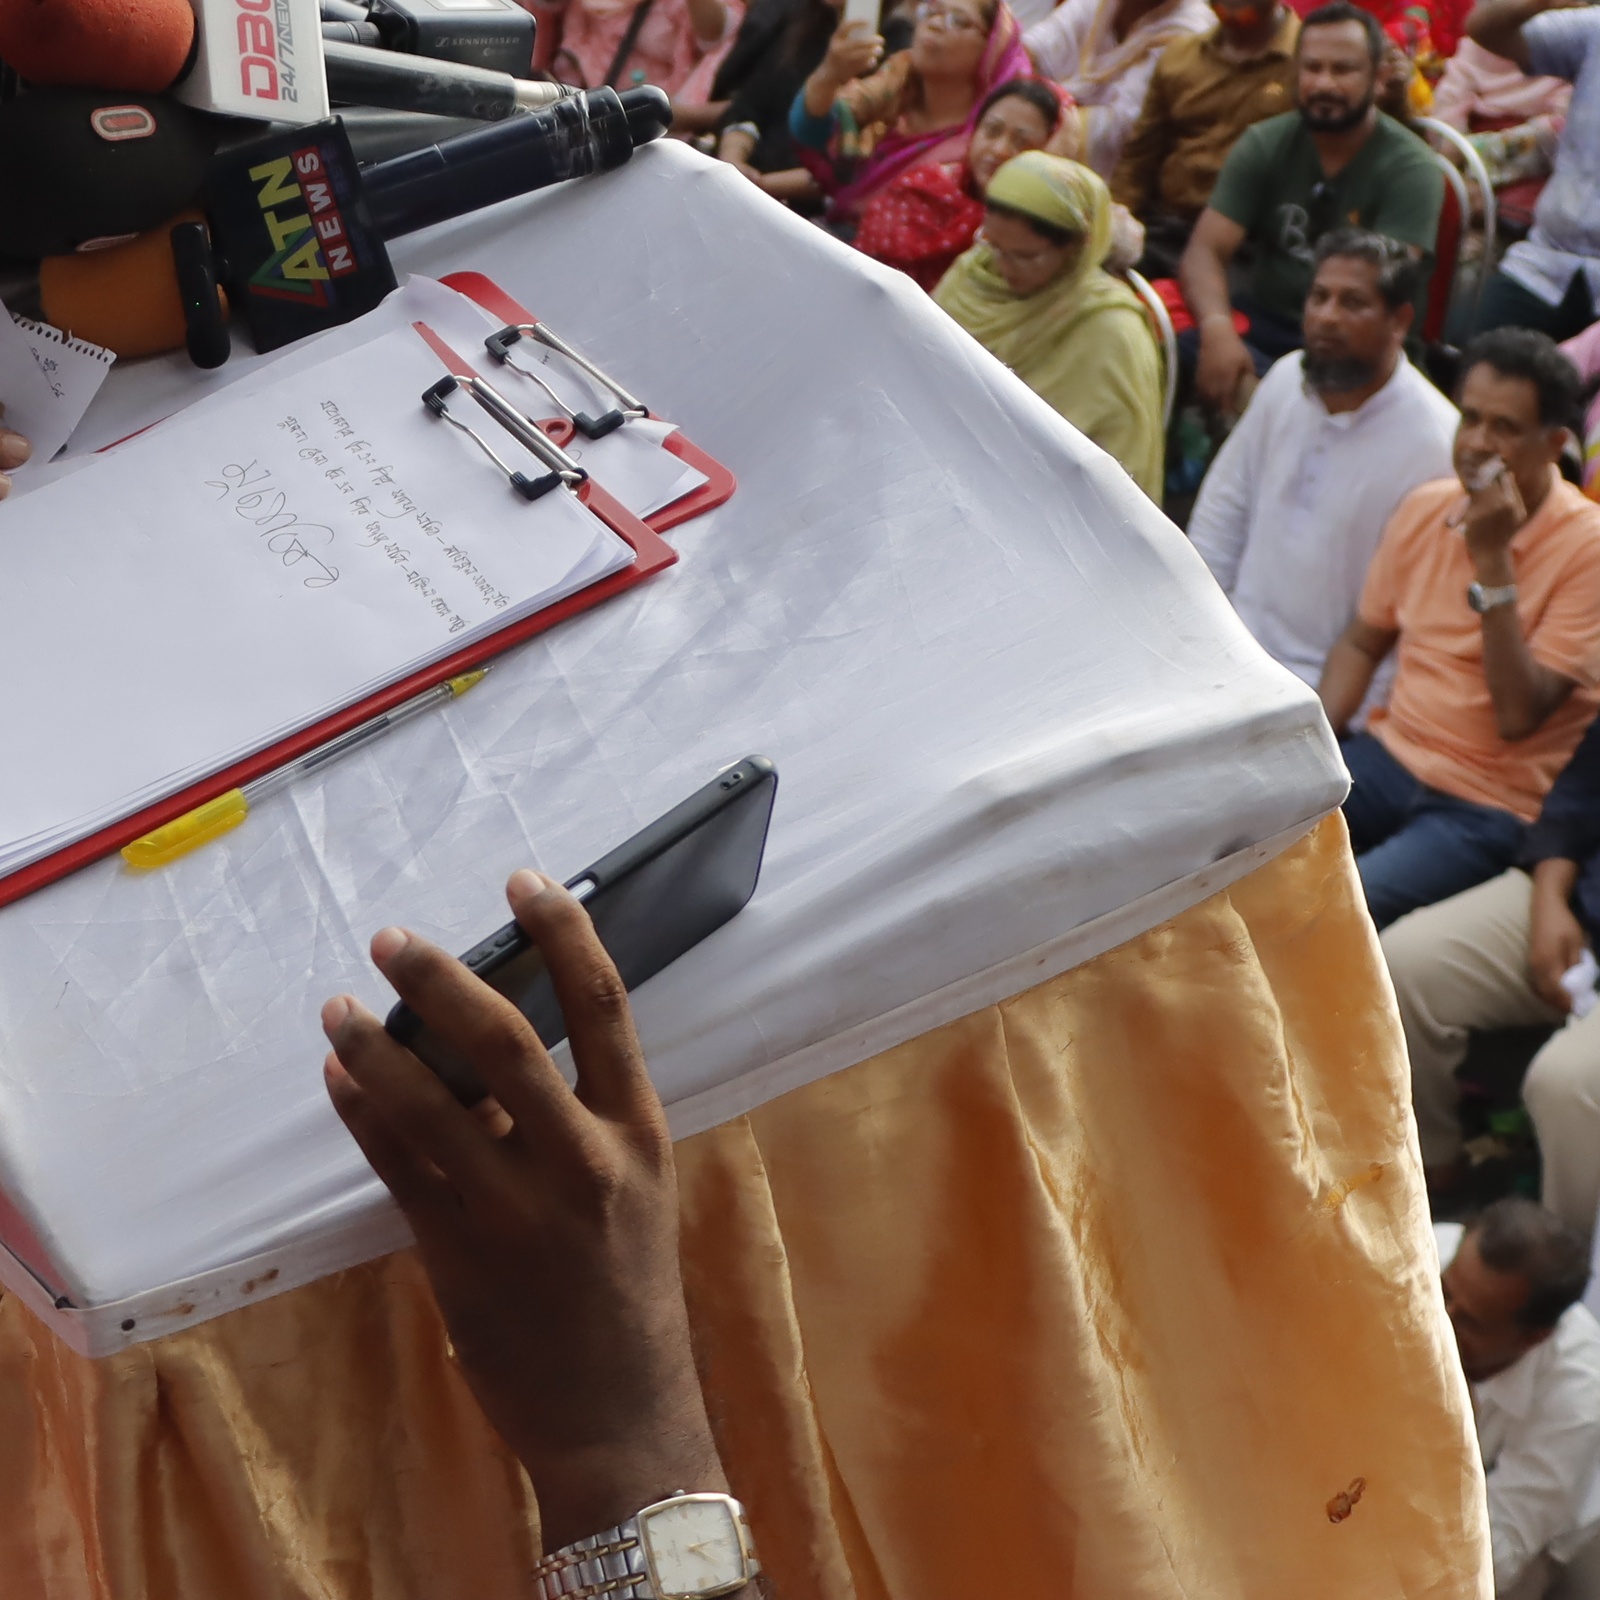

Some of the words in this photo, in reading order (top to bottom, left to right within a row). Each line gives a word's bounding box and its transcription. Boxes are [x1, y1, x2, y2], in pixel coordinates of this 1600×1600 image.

[452, 37, 521, 45] SENNHEISER
[248, 155, 330, 280] ATN
[297, 152, 353, 272] NEWS
